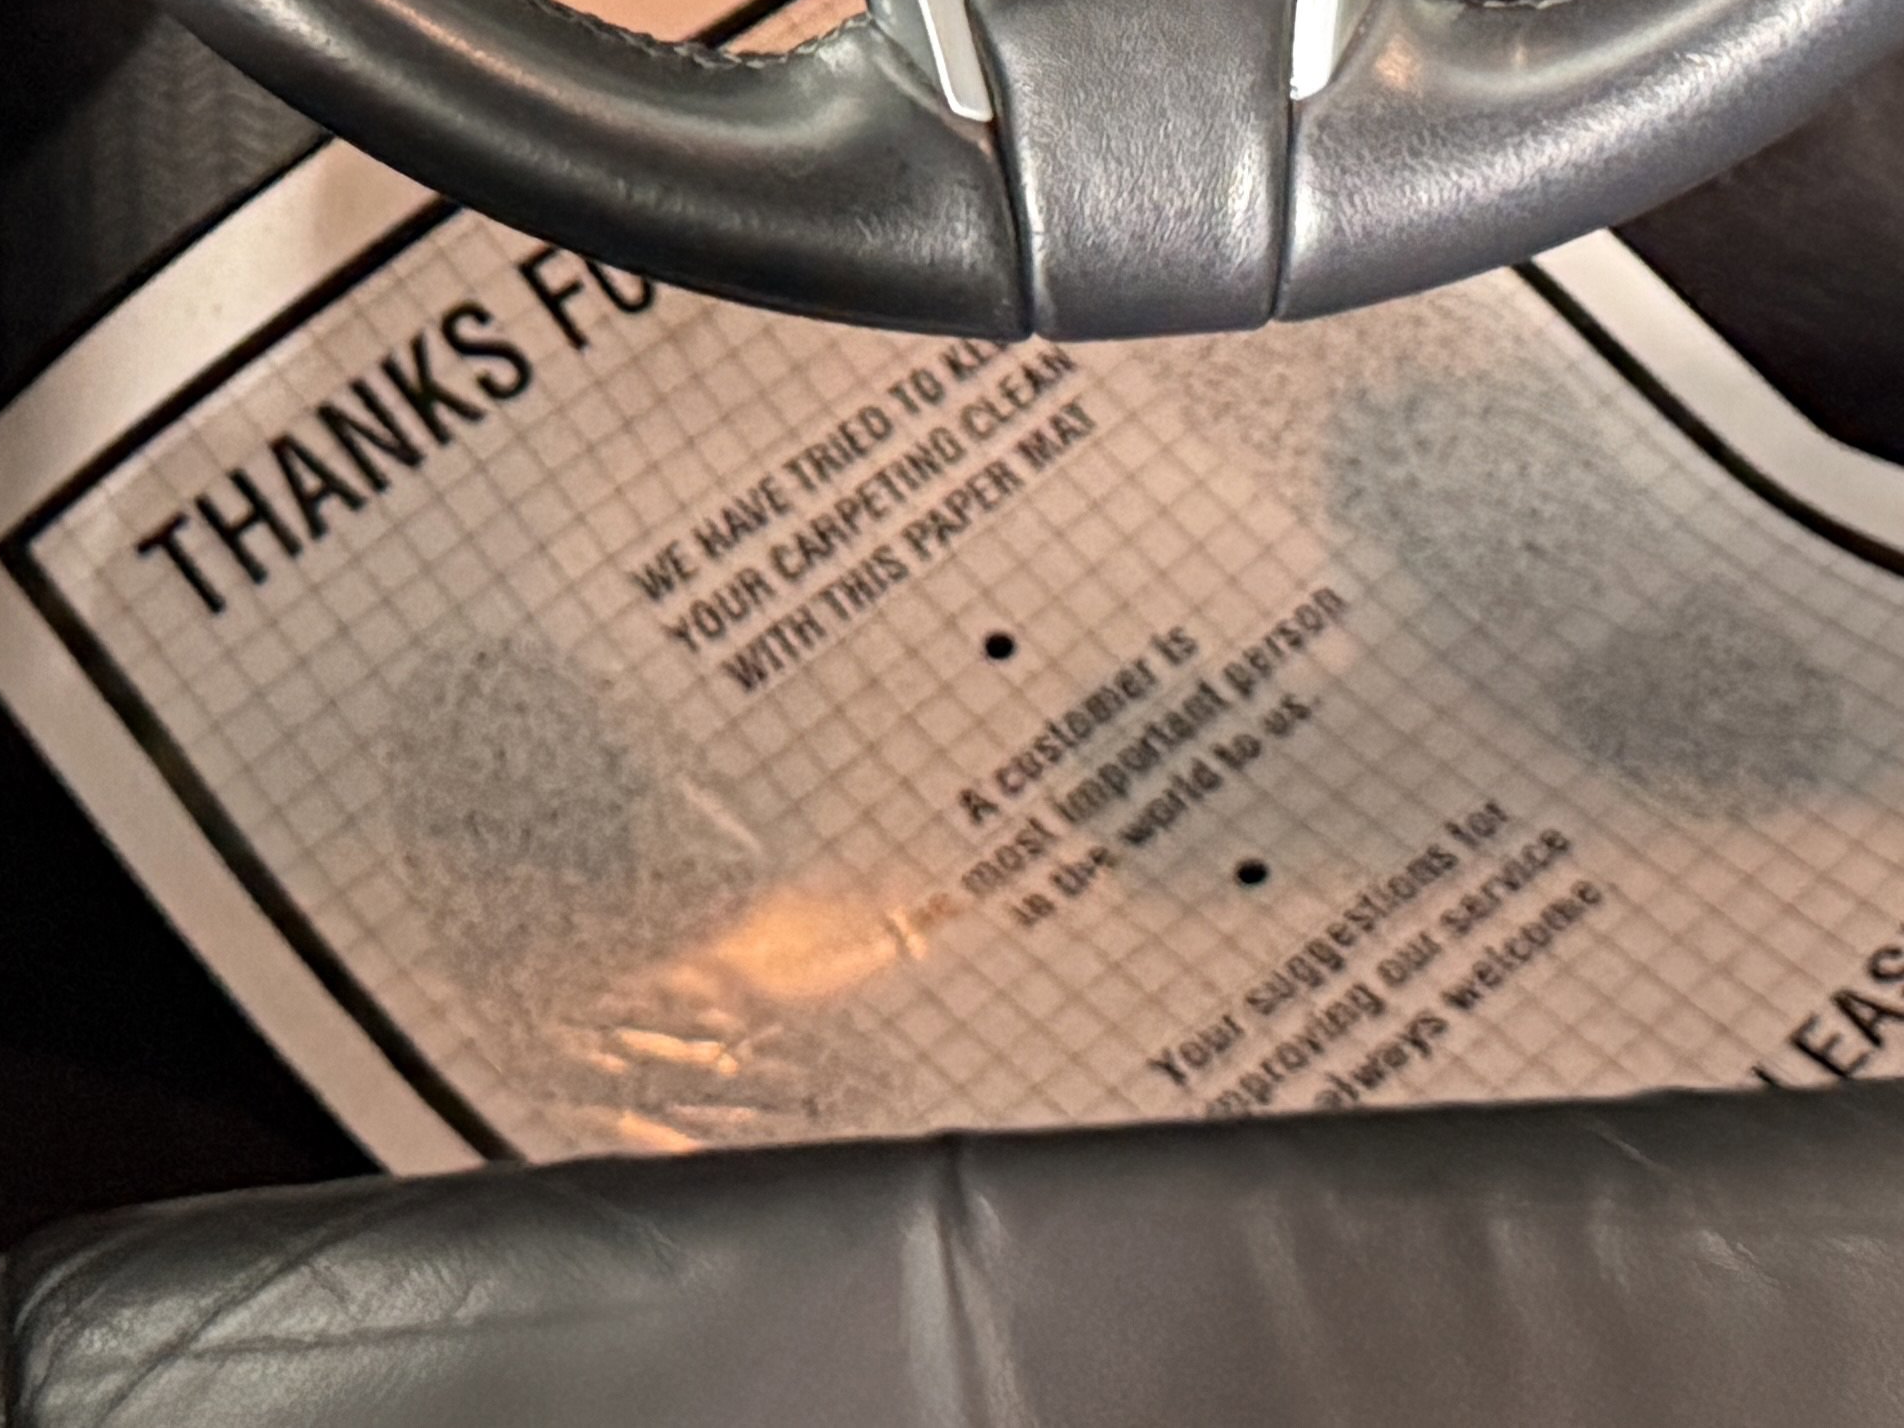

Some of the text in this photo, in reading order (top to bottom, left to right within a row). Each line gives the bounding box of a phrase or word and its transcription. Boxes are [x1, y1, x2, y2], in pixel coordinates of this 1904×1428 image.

[137, 300, 534, 615] THANKS
[632, 367, 946, 603] WE HAVE TRIED TO
[664, 345, 1078, 653] YOUR CARPETING CLEAN
[722, 397, 1098, 693] WITH THIS PAPER MAT
[959, 625, 1199, 826] A customer is
[961, 587, 1347, 898] most important person
[1011, 892, 1057, 928] in
[1048, 846, 1118, 898] the
[1119, 756, 1224, 847] world
[1214, 733, 1262, 772] to
[1147, 801, 1509, 1087] Your suggestions for
[1313, 879, 1604, 1110] always welcome
[1376, 828, 1572, 989] our service
